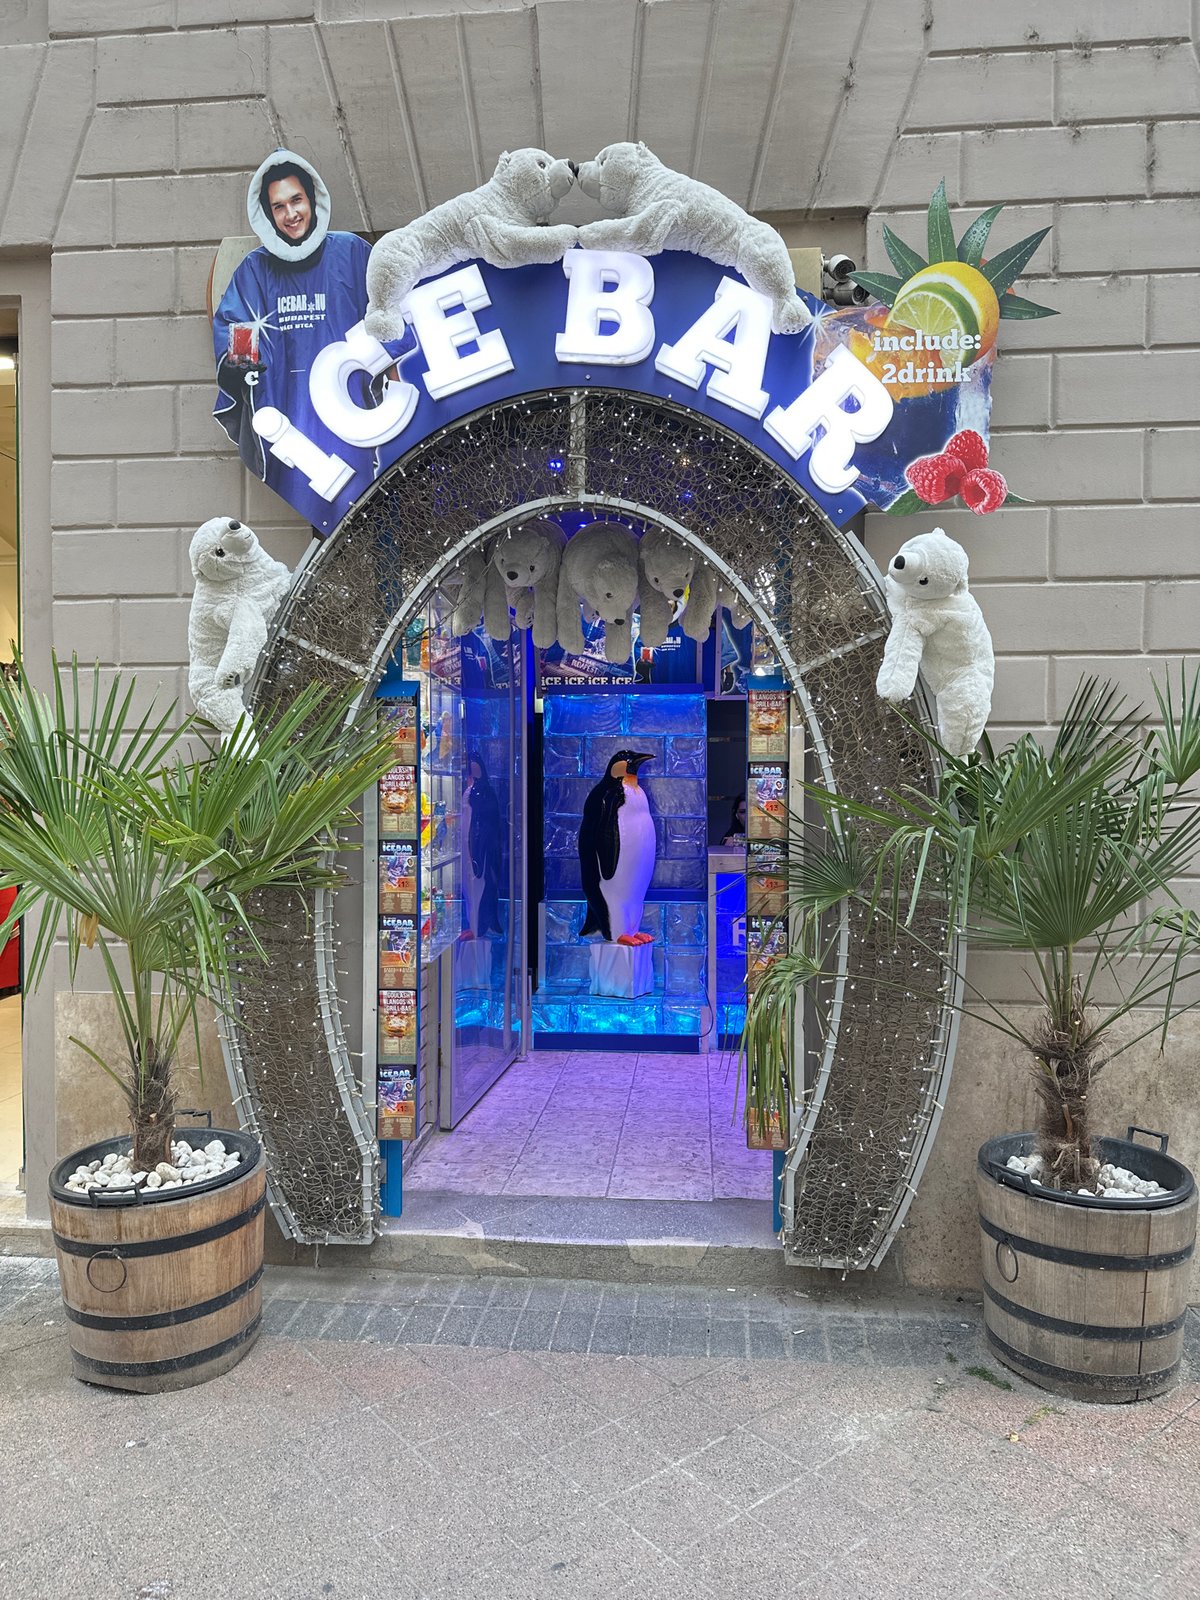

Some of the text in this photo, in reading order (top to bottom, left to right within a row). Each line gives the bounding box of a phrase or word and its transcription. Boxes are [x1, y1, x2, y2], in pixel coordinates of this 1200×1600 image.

[278, 313, 326, 323] BUDAPEST
[873, 329, 982, 352] include:
[555, 248, 895, 495] BAR
[881, 361, 972, 384] 2drink
[541, 676, 561, 686] iCE
[564, 676, 585, 686] iCE
[588, 676, 608, 686] iCE
[751, 766, 782, 776] ICEBAR
[382, 844, 413, 853] ICEBAR
[383, 919, 414, 928] ICEBAR
[379, 1069, 411, 1078] ICEBAR
